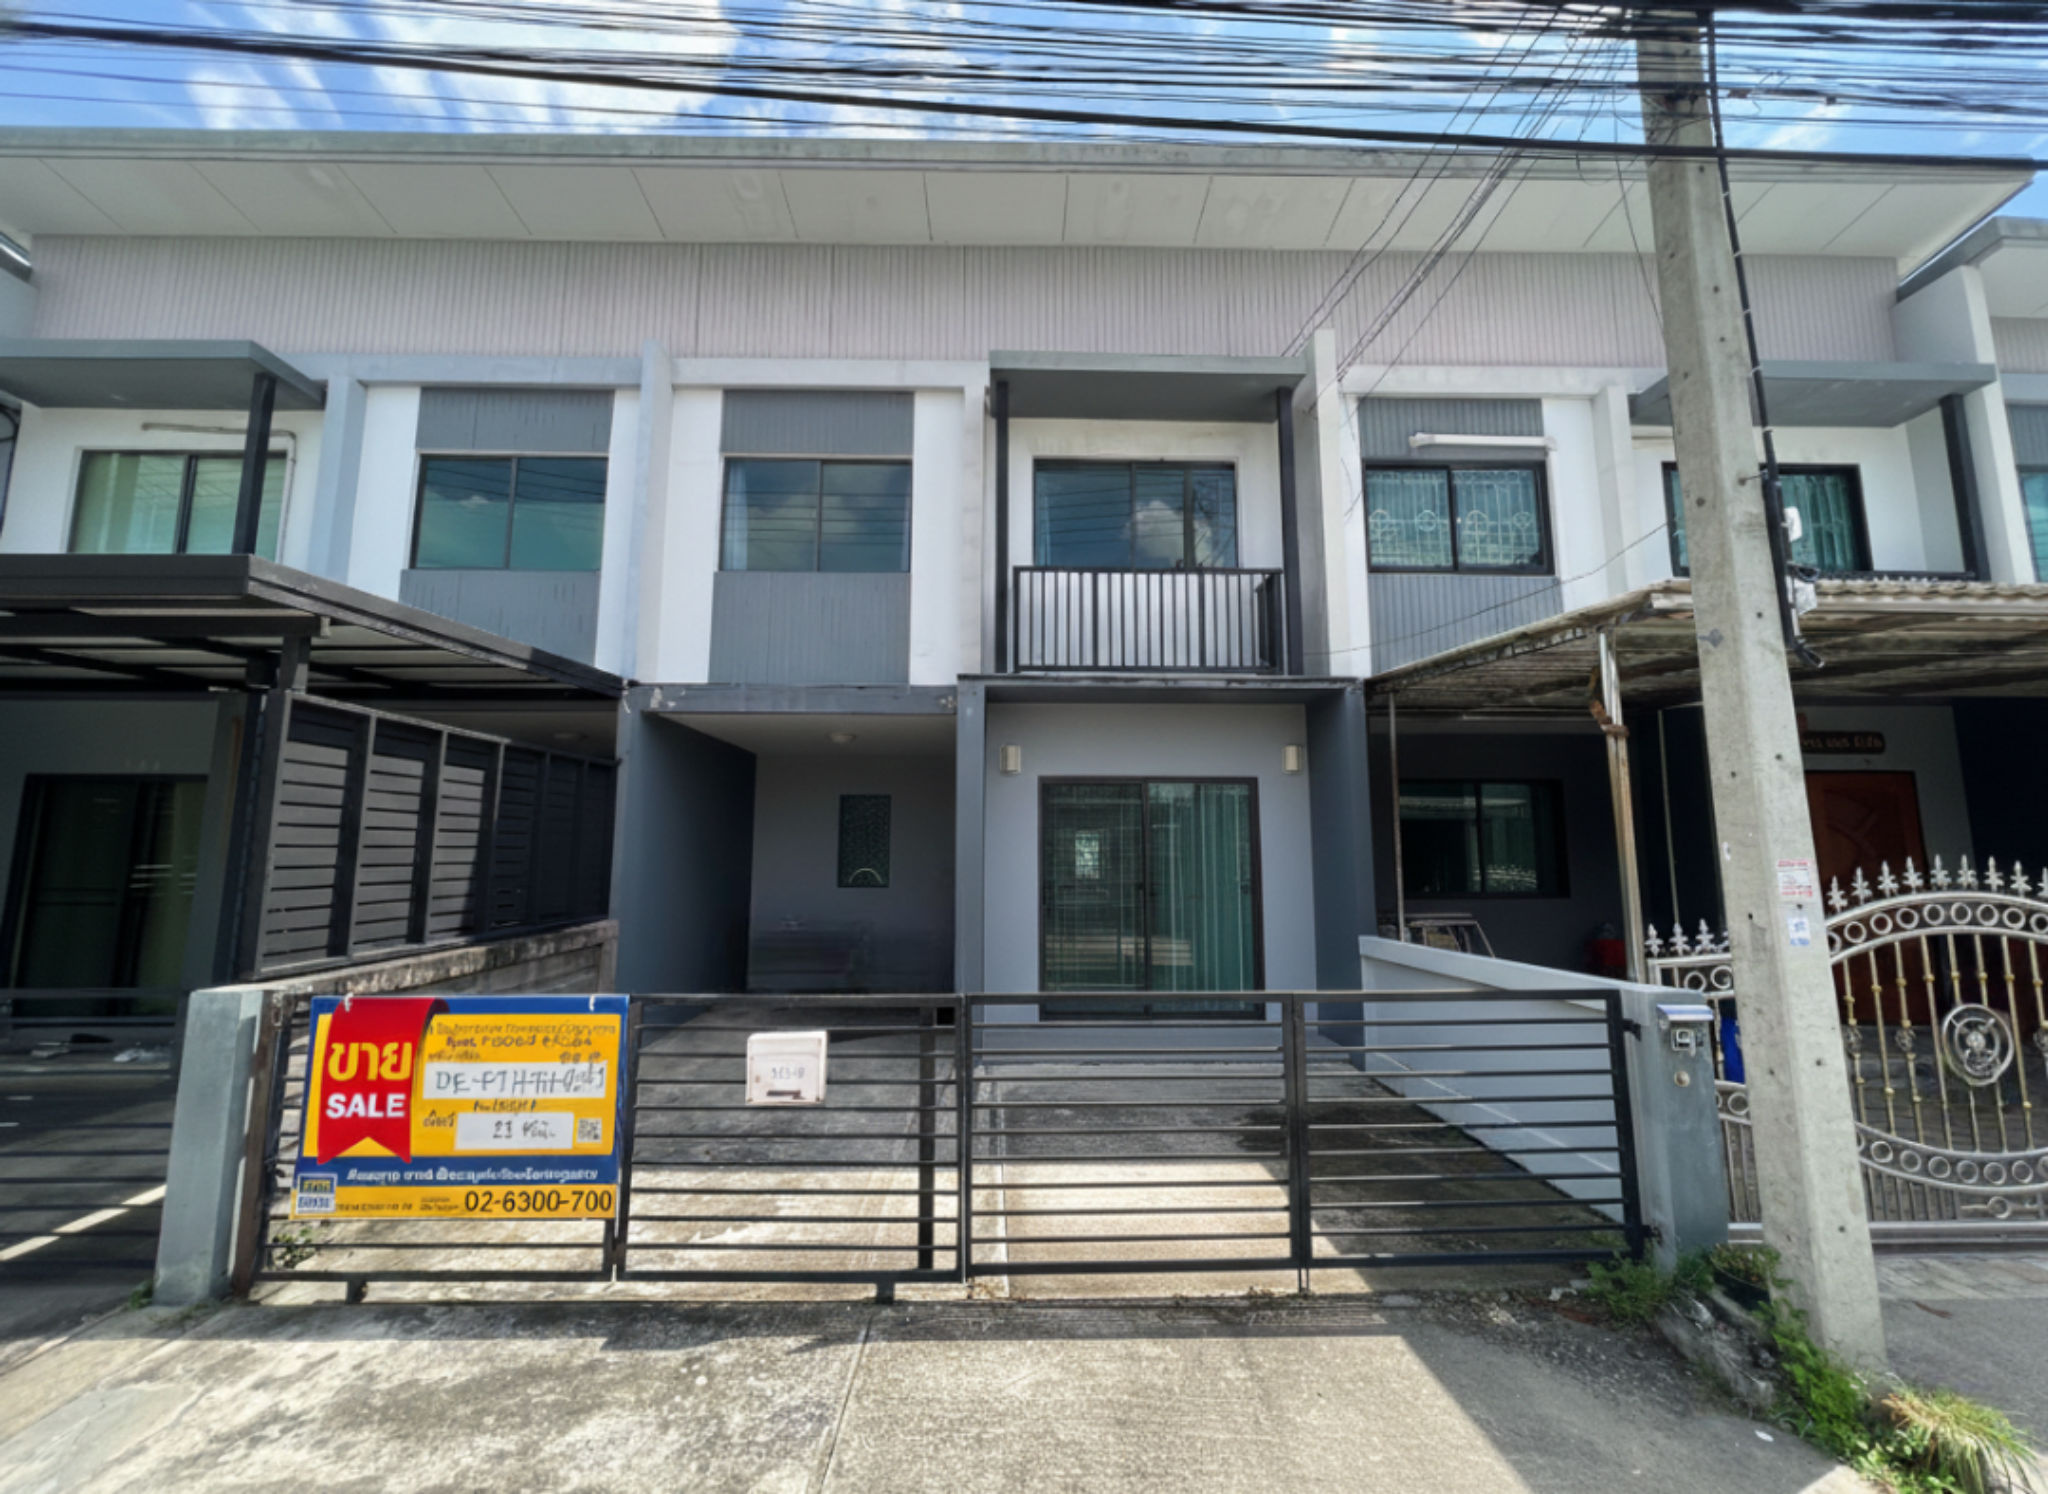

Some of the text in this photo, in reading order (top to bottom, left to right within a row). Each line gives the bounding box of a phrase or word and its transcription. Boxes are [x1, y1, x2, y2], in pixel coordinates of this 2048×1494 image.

[328, 1042, 412, 1081] ขาย
[326, 1093, 405, 1118] SALE
[464, 1190, 612, 1212] 02-6300-700
